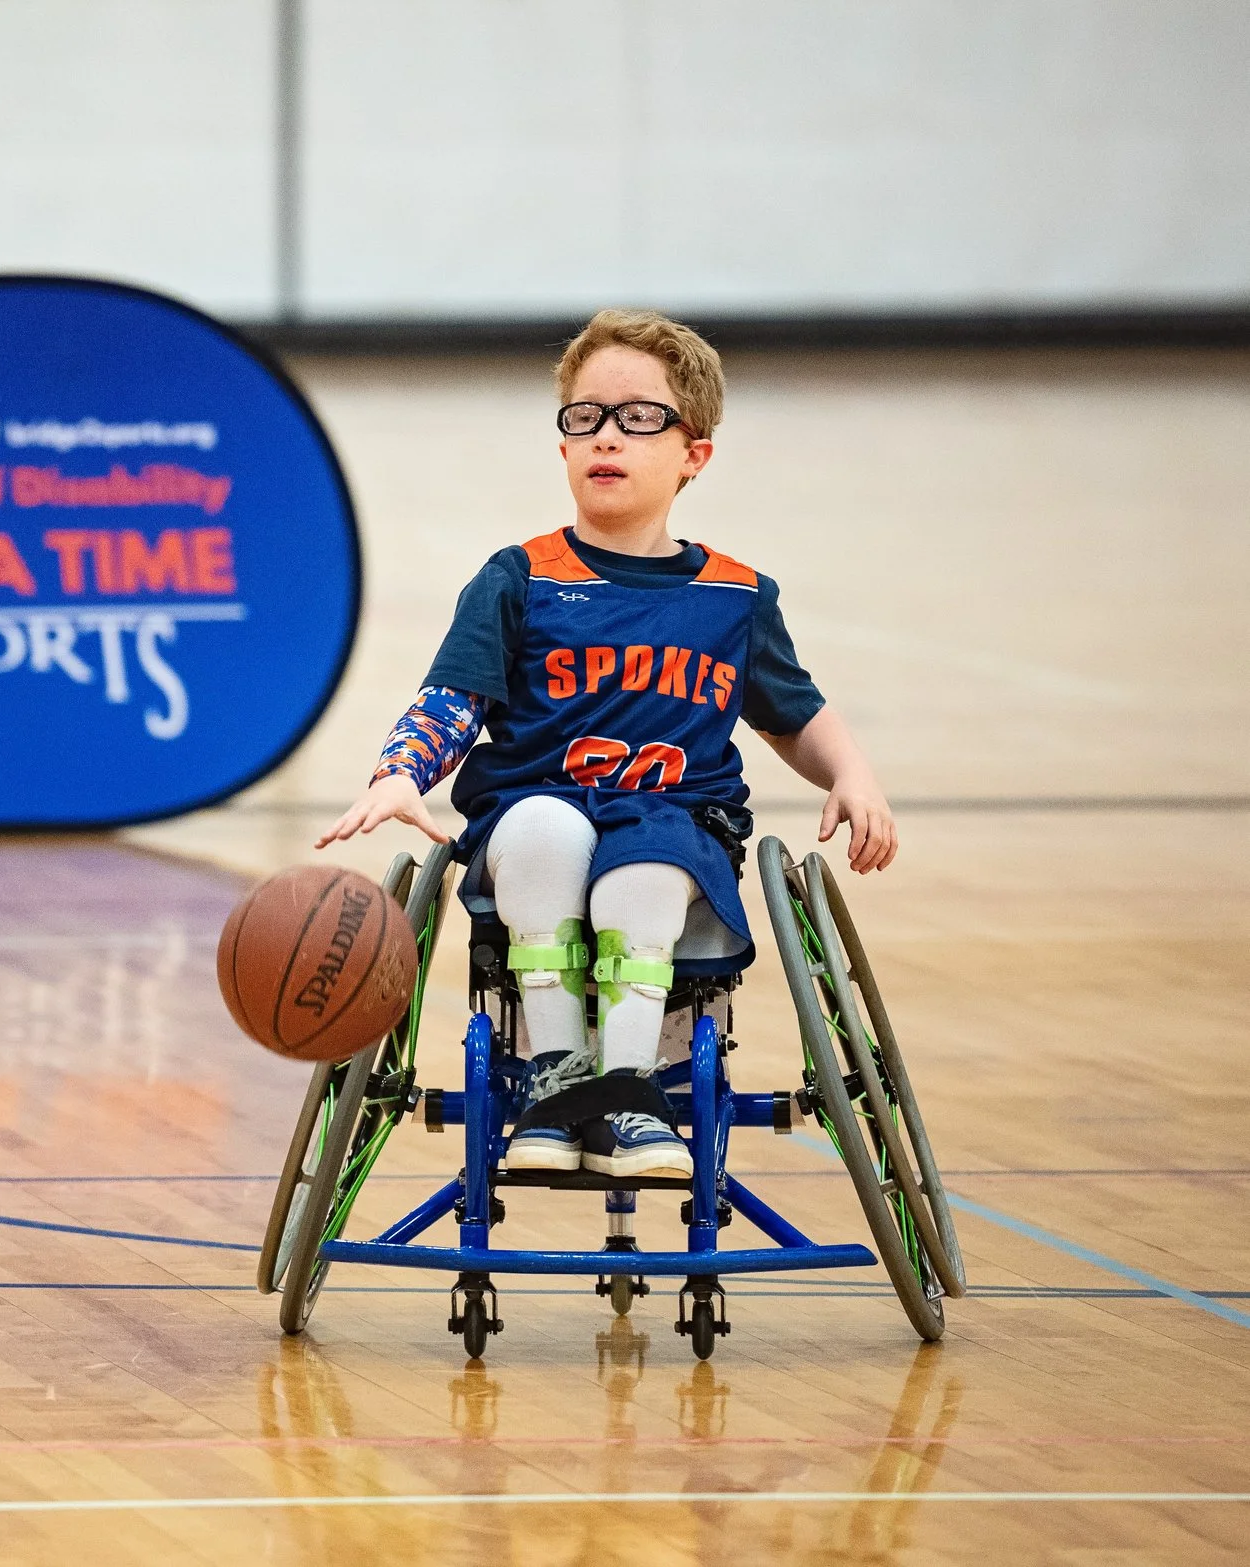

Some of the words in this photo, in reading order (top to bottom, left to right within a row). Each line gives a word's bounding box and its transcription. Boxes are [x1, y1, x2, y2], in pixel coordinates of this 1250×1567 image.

[11, 464, 231, 515] Disability
[43, 527, 237, 595] TIME
[545, 645, 737, 712] SPOKES
[293, 886, 373, 1018] SPALDING
